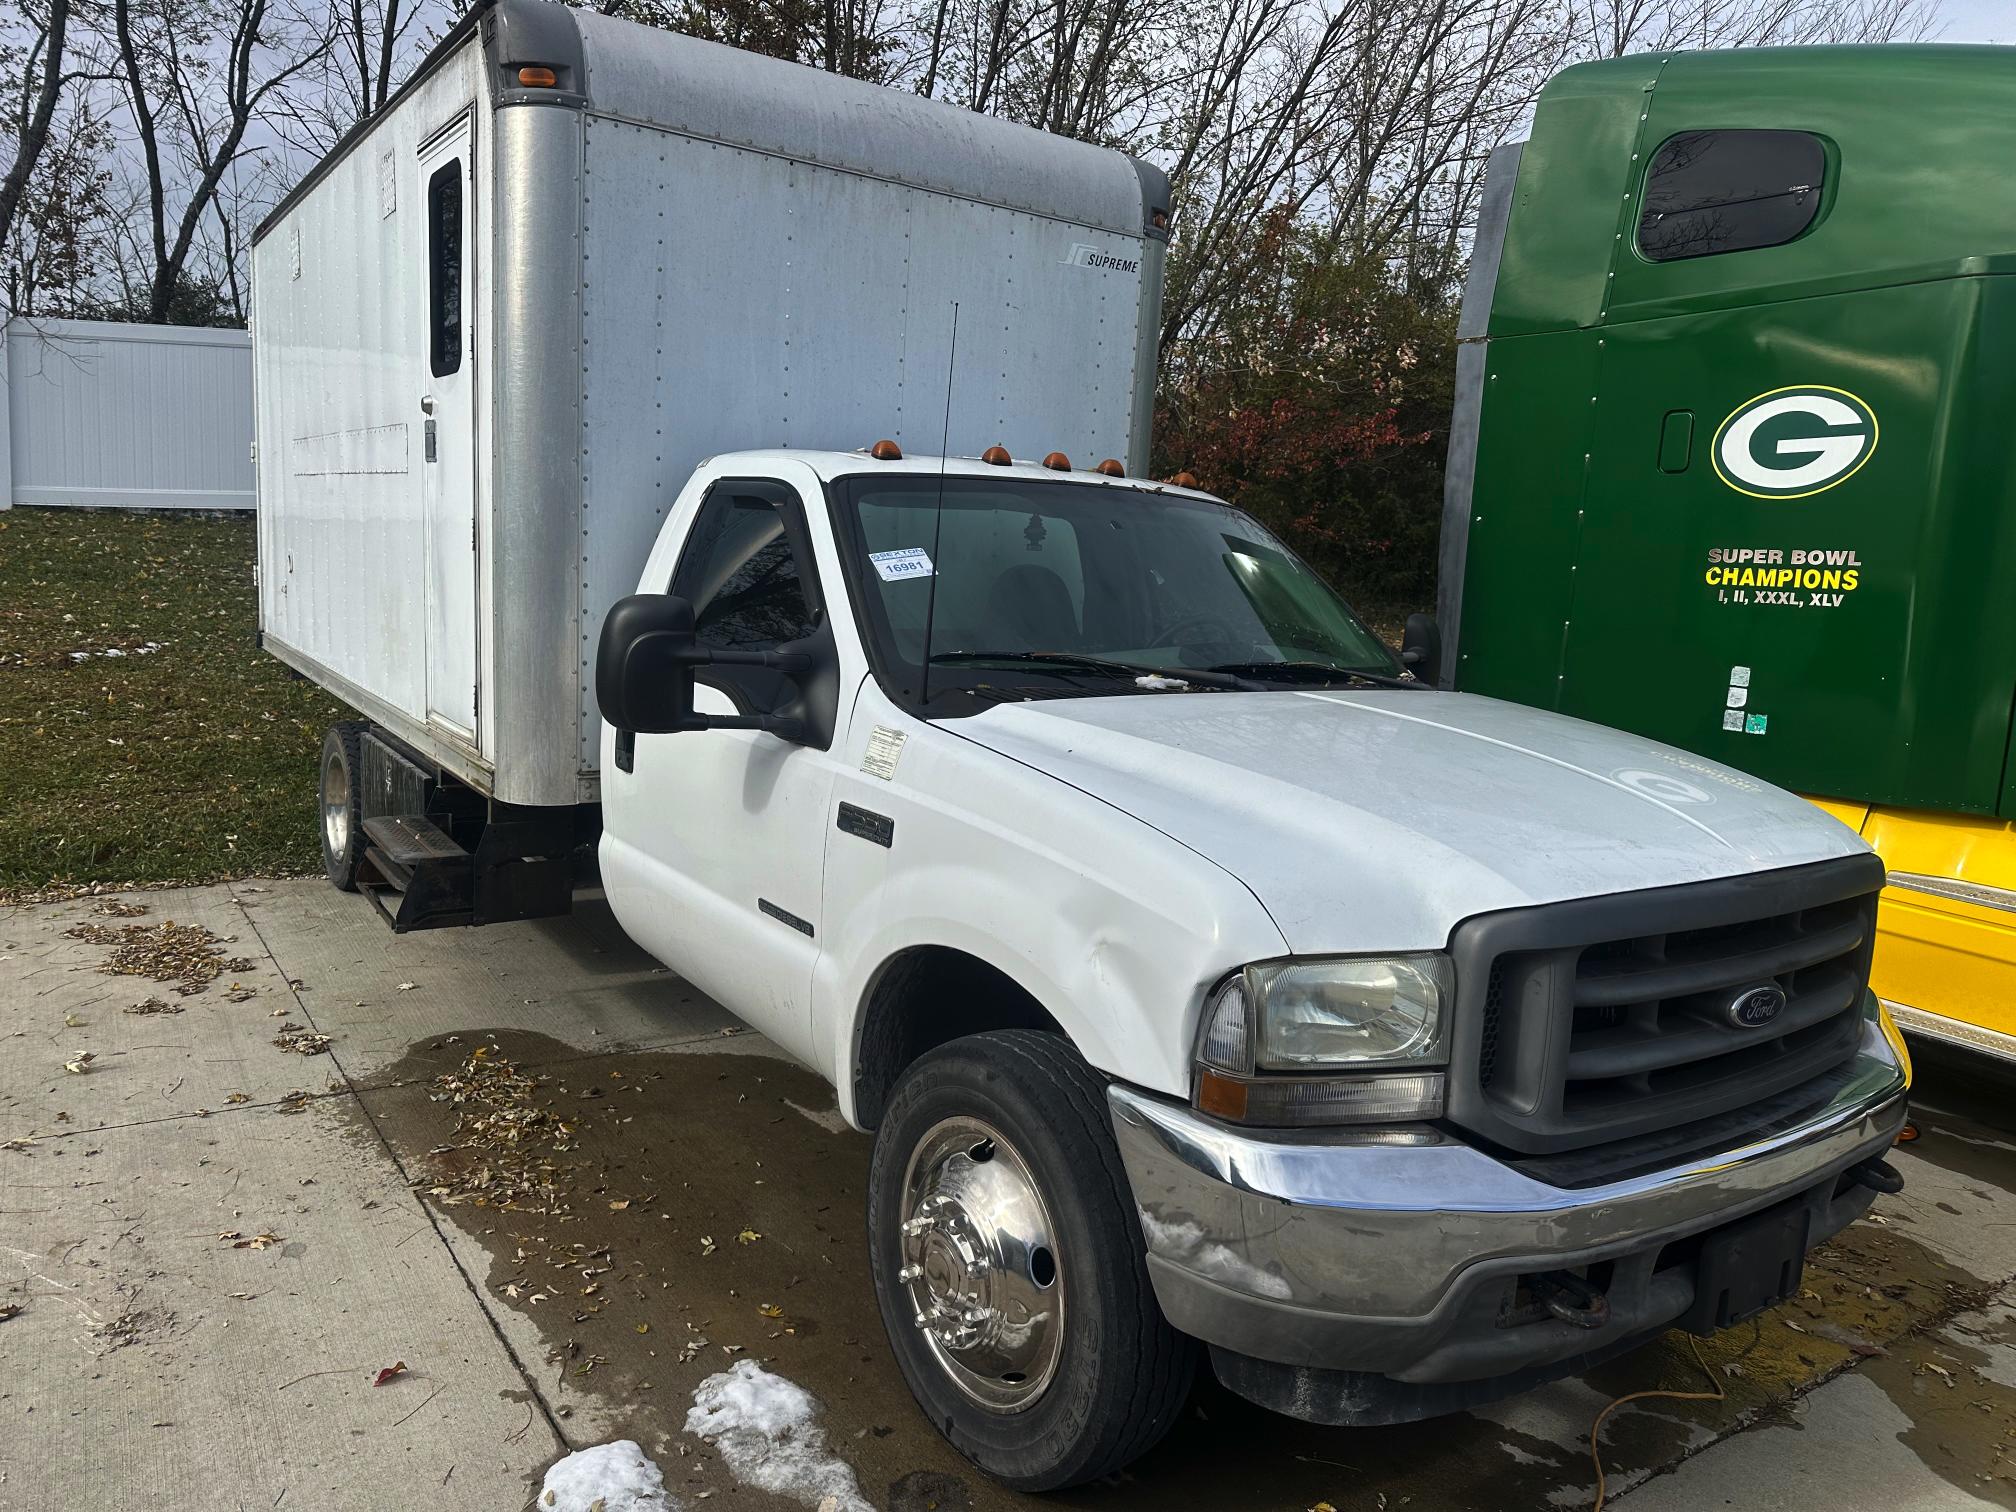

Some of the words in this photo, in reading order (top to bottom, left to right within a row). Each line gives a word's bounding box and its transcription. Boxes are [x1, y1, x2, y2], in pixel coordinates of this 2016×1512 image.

[1088, 253, 1138, 273] SUPREME
[1721, 395, 1866, 489] G
[886, 561, 924, 573] 16981
[1708, 548, 1784, 565] SUPER
[1791, 550, 1862, 566] BOWL
[1705, 567, 1860, 591] CHAMPIONS
[1718, 589, 1728, 604] I,
[1734, 590, 1749, 605] II,
[1754, 590, 1804, 608] XXXL,
[1809, 593, 1845, 607] XLV
[1747, 996, 1777, 1020] Ford
